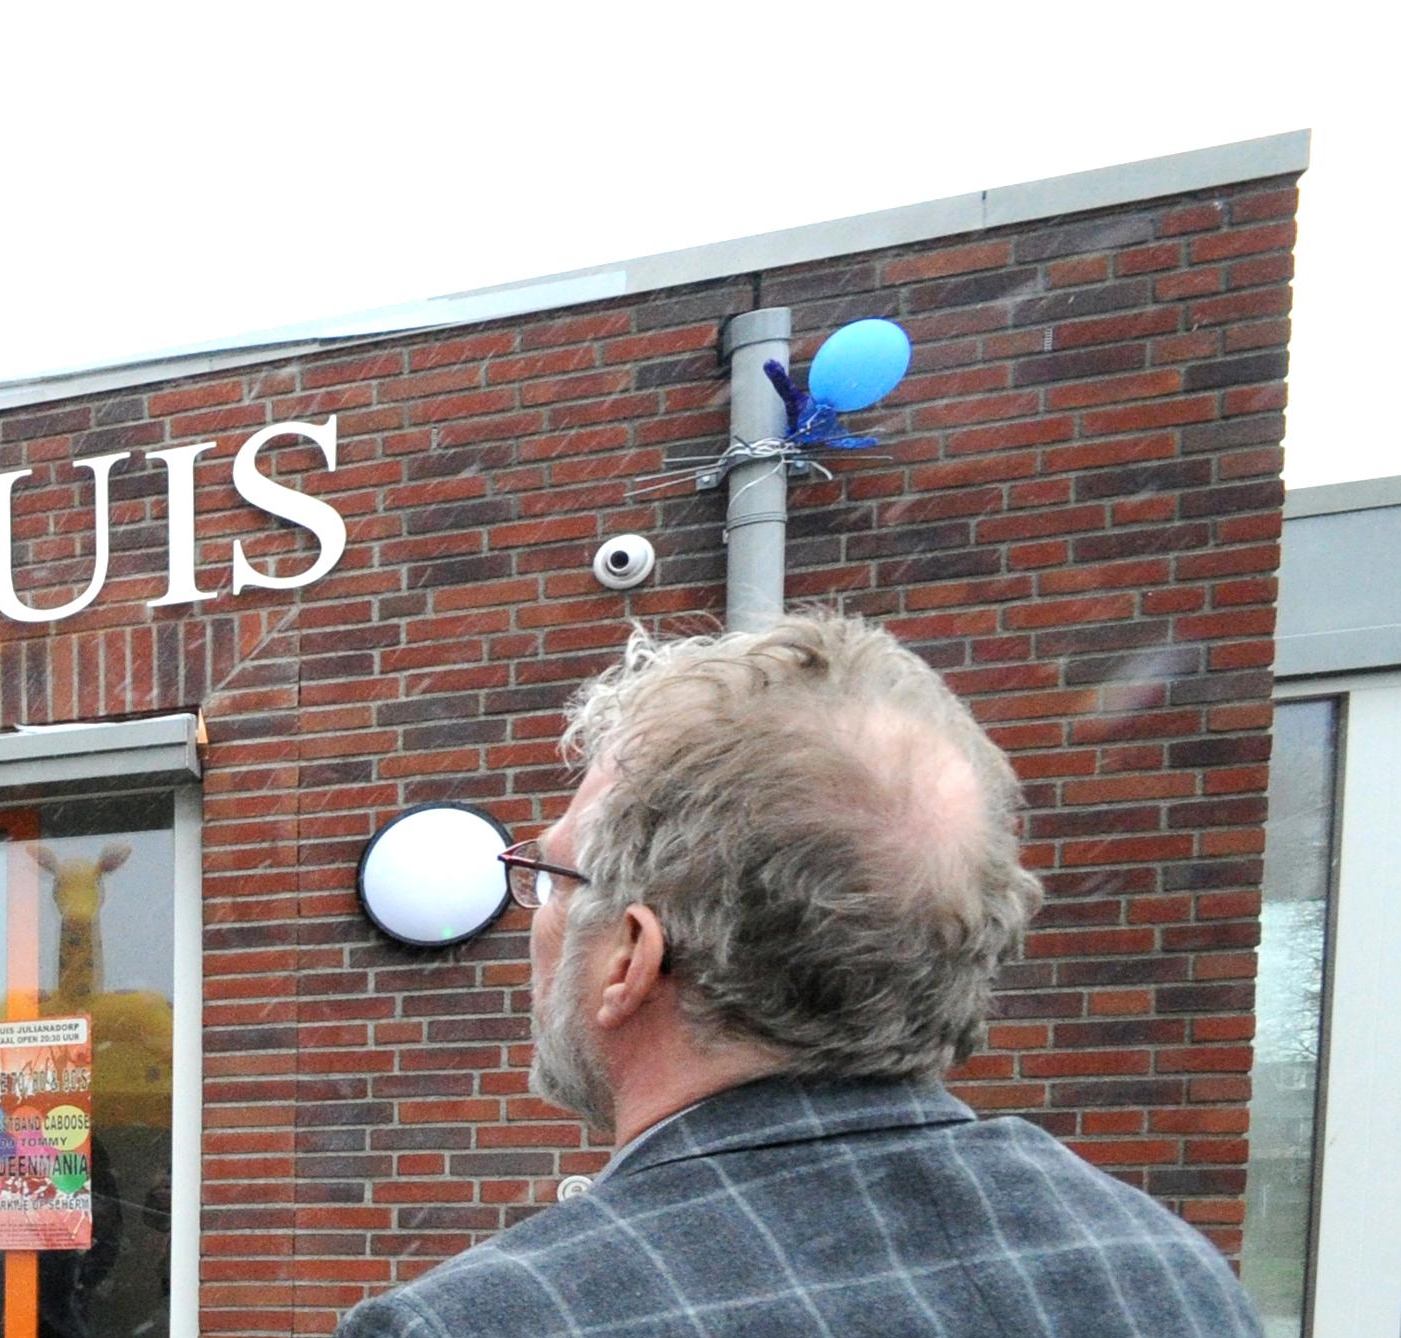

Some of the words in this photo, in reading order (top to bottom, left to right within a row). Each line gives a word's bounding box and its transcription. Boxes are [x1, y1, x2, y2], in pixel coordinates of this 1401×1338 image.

[16, 1023, 80, 1034] JULIANADORP
[17, 1036, 38, 1044] OPEN
[63, 1033, 79, 1041] UUR
[44, 1114, 90, 1131] CABOOSE
[21, 1136, 67, 1147] TOMMY
